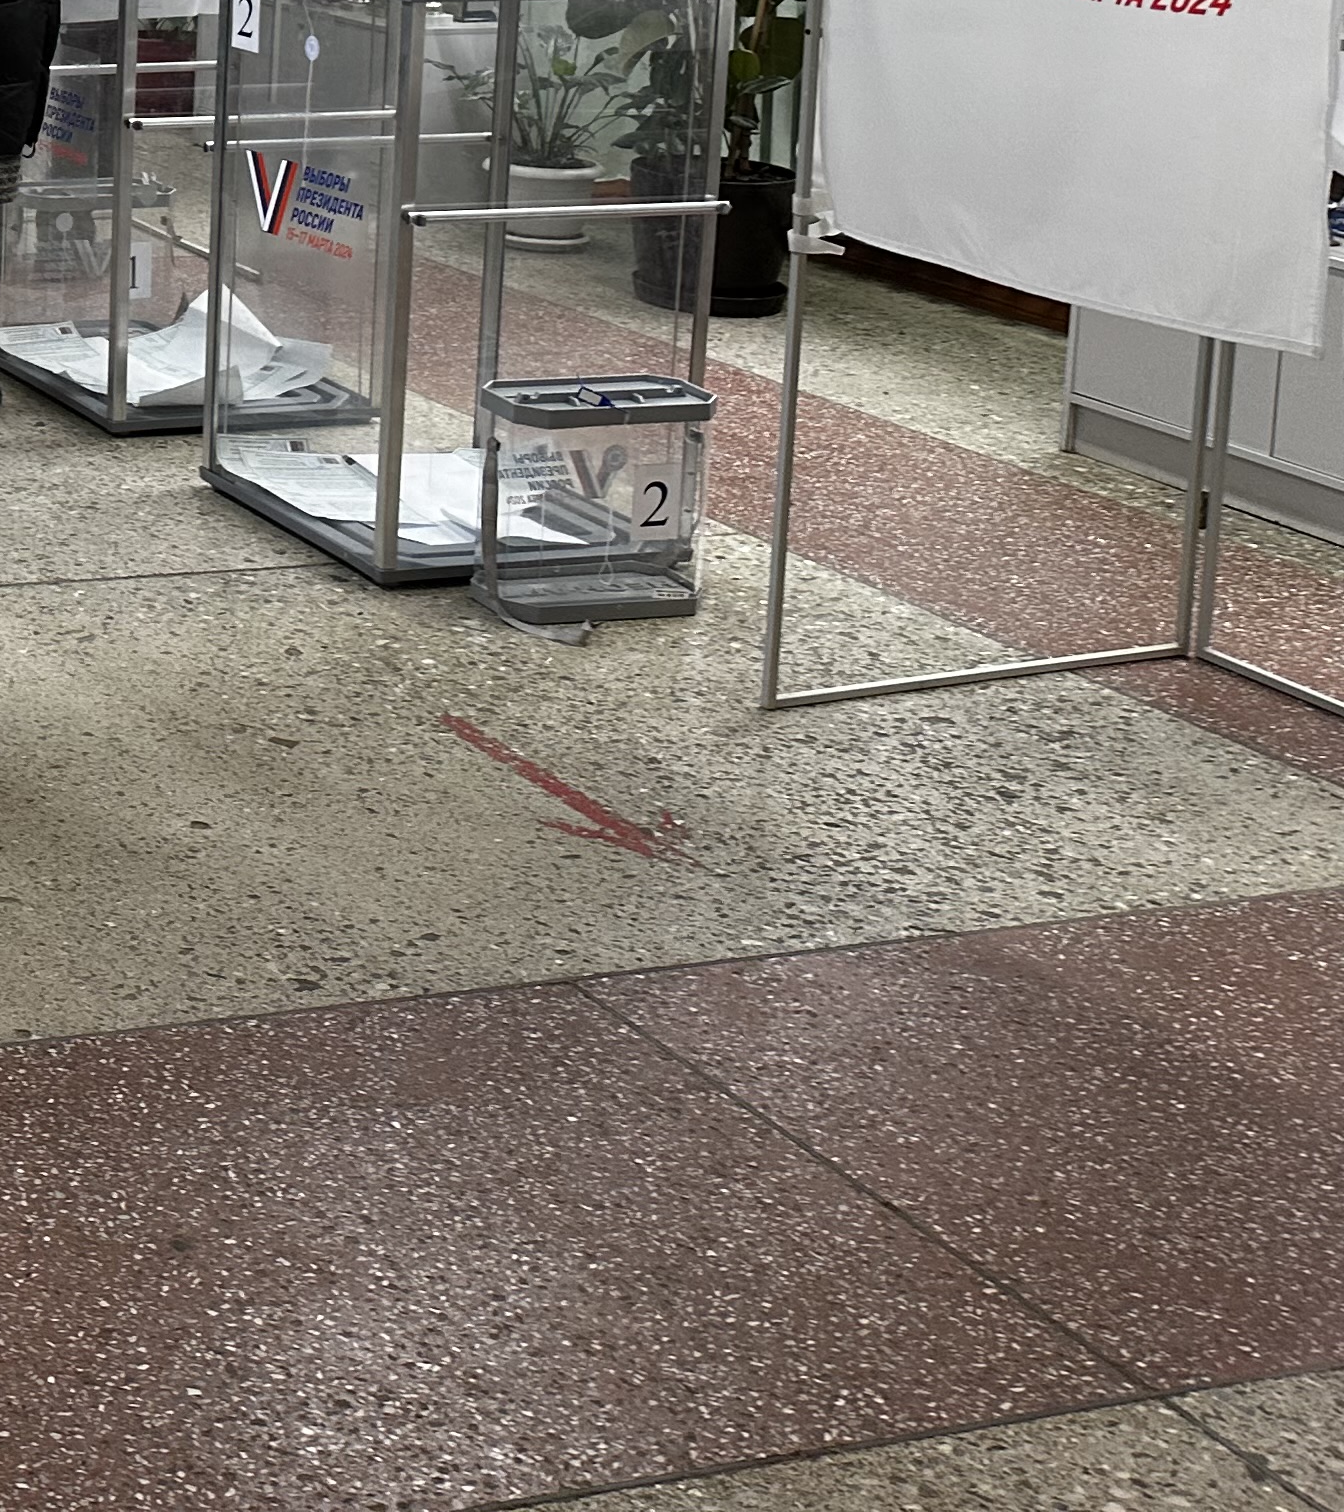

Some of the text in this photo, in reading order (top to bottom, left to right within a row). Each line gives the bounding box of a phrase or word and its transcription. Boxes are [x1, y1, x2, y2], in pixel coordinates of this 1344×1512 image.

[303, 166, 351, 194] ВЫБОРЫ
[296, 187, 364, 221] ПРЕЗИДЕНТА
[290, 207, 334, 233] РОССИИ
[640, 480, 670, 528] 2
